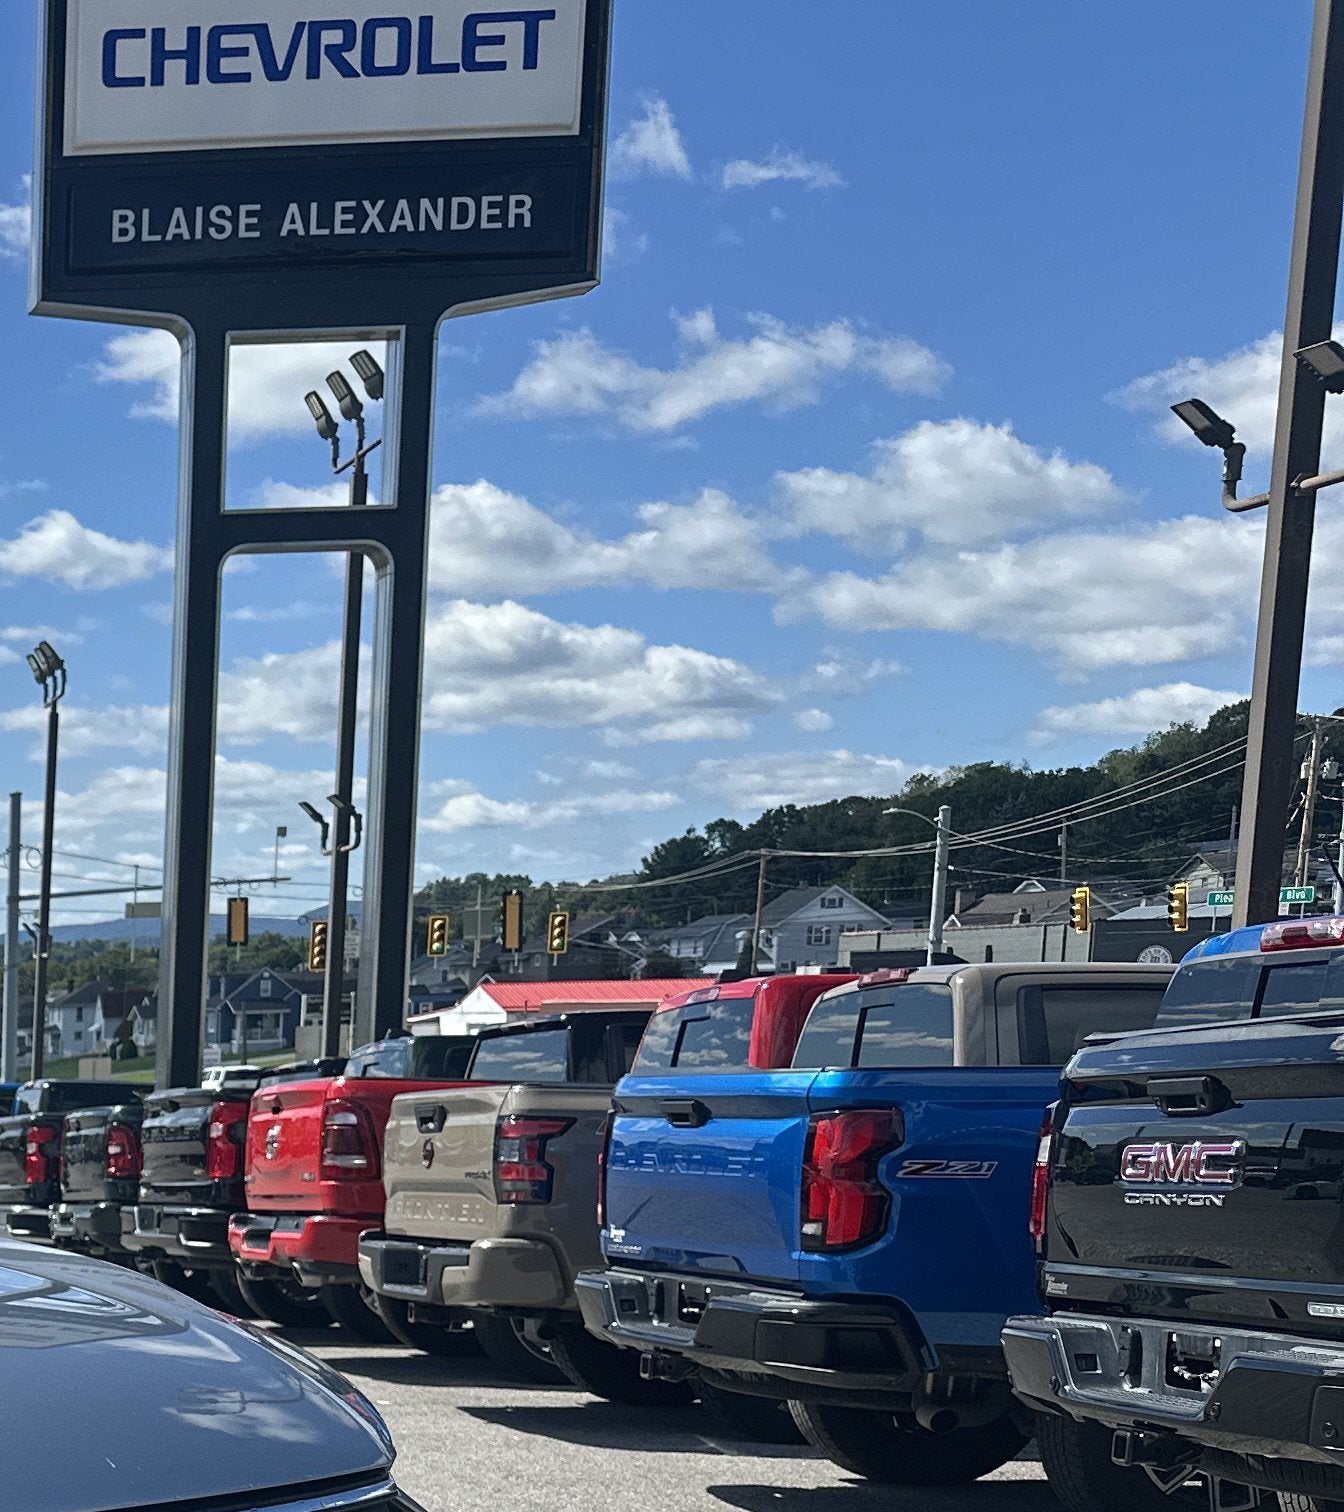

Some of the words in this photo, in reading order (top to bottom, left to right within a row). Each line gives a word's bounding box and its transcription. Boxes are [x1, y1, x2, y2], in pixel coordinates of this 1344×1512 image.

[101, 9, 556, 88] CHEVROLET
[111, 203, 262, 244] BLAISE
[279, 194, 533, 238] ALEXANDER
[896, 1159, 999, 1178] Z71
[1120, 1142, 1239, 1183] GMC
[1124, 1192, 1226, 1207] CANYON
